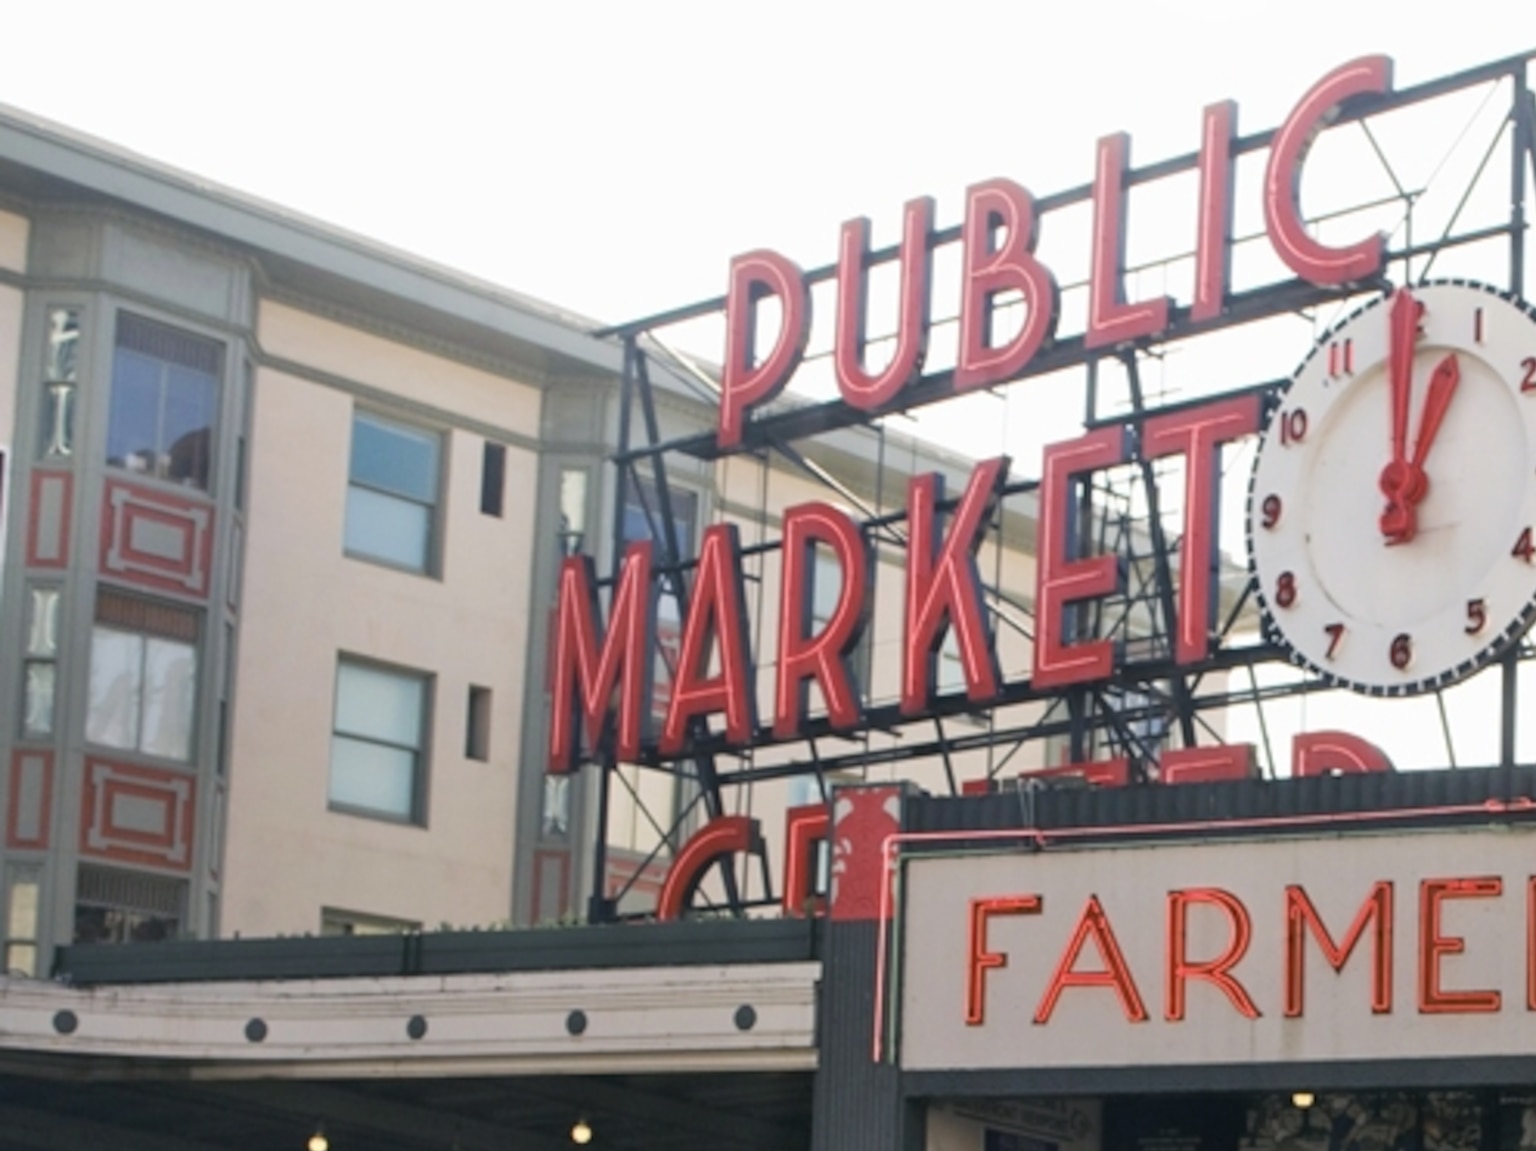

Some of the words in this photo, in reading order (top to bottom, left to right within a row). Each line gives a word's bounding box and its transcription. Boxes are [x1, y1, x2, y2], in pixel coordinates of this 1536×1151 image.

[718, 54, 1394, 446] PUBLIC
[1473, 307, 1484, 344] 1
[1328, 338, 1354, 380] 11
[1280, 409, 1307, 448] 10
[1262, 493, 1283, 530] 9
[1511, 526, 1536, 564] 4
[545, 394, 1262, 775] MARKET
[1275, 571, 1297, 609] 8
[1464, 597, 1488, 635] 5
[1323, 623, 1346, 661] 7
[1389, 633, 1412, 671] 6
